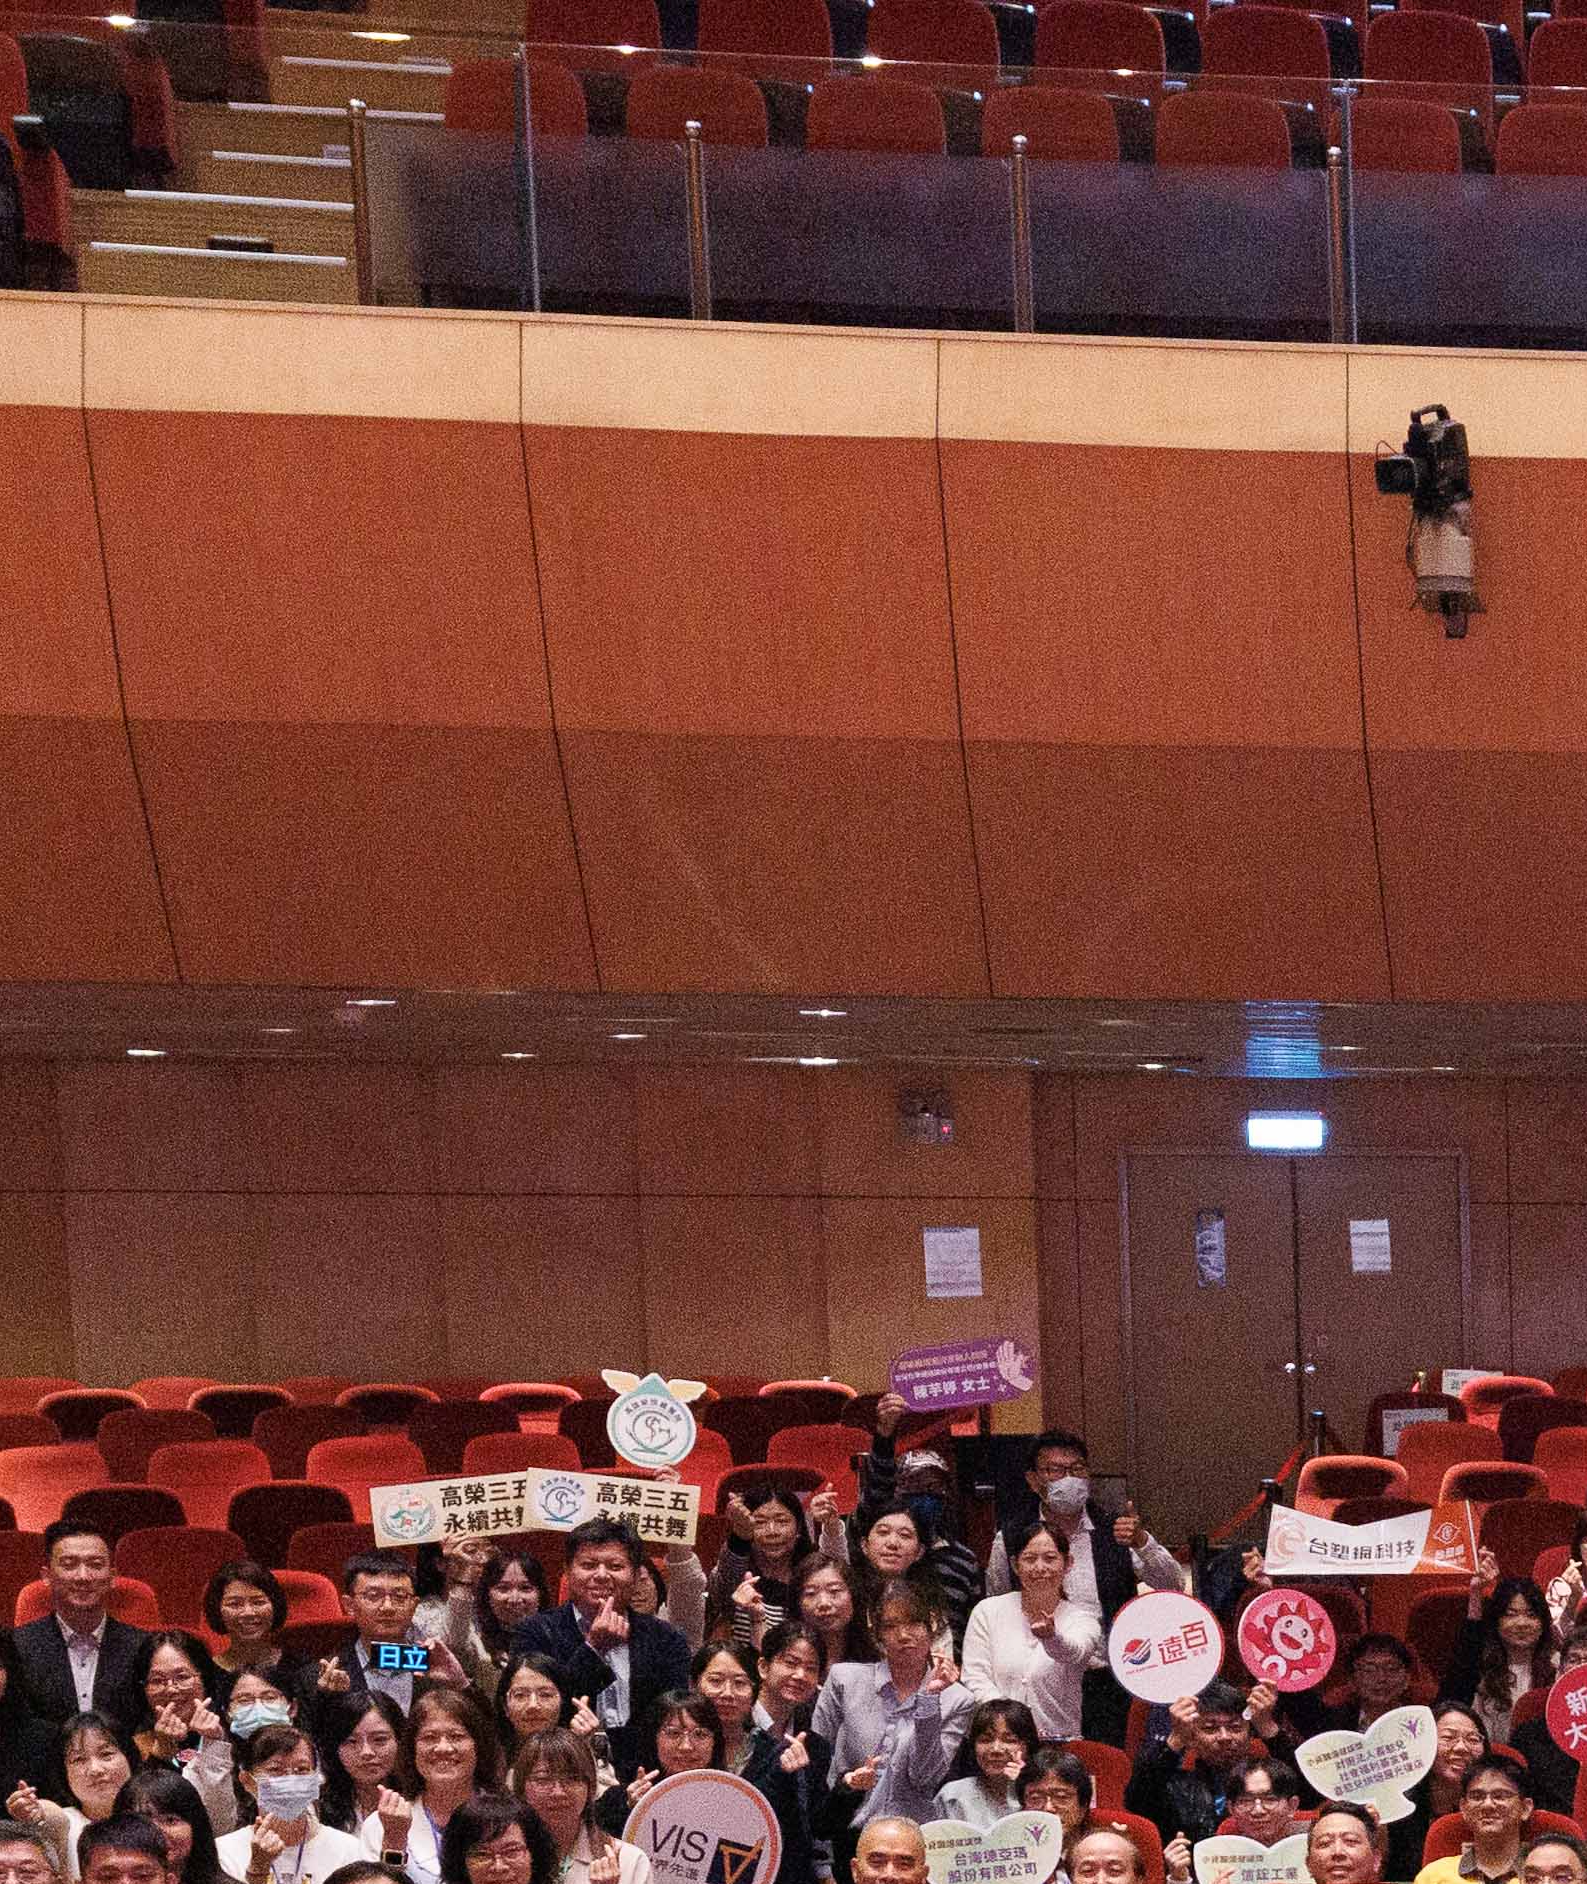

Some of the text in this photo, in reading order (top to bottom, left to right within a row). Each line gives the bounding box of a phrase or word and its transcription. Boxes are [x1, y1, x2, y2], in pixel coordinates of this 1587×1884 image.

[596, 1481, 689, 1512] 高榮三五
[379, 1645, 428, 1670] 日立
[651, 1819, 708, 1863] VIS
